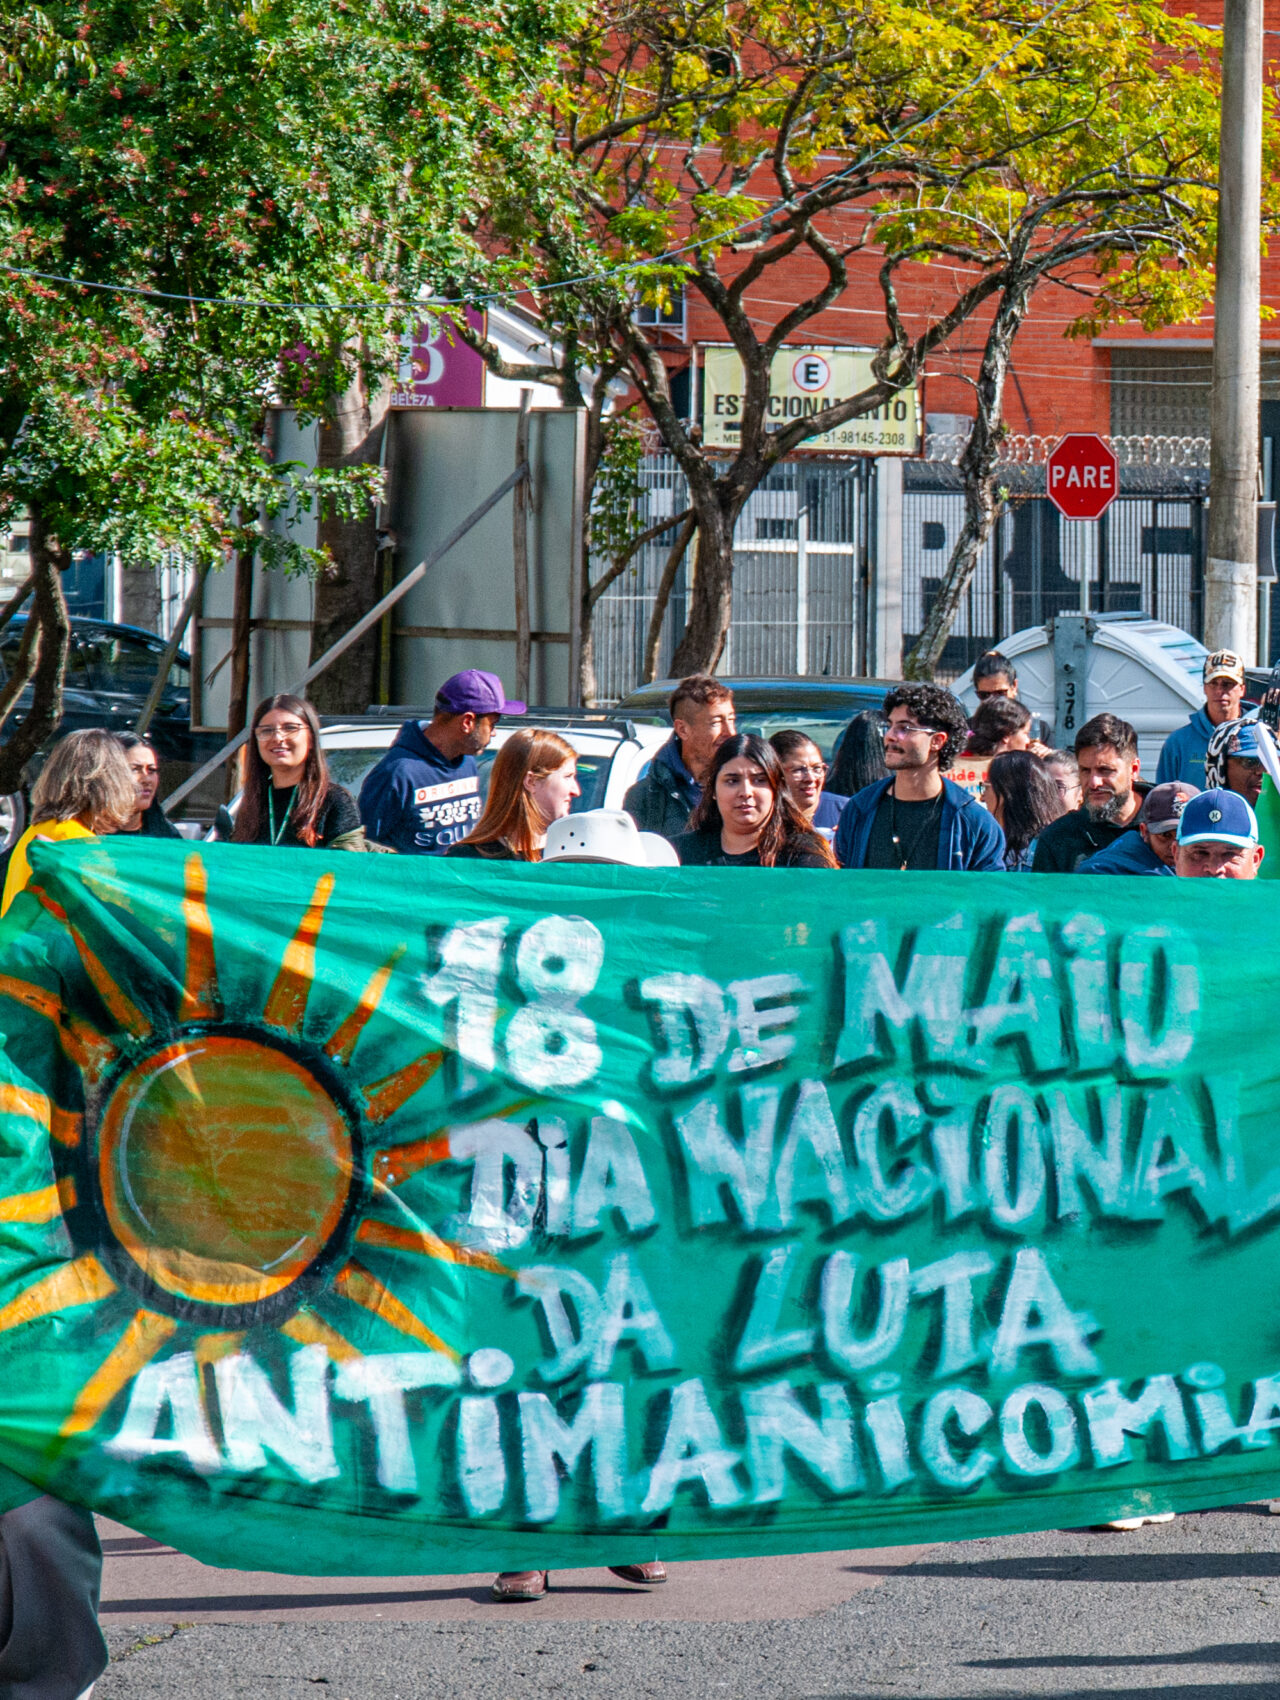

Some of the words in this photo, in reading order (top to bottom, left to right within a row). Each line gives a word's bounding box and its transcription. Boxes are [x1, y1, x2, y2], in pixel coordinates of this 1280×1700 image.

[804, 363, 819, 384] E
[823, 430, 905, 446] 51-98145-2308
[1052, 465, 1112, 488] PARE
[420, 915, 604, 1093] 18
[640, 972, 800, 1083] DE
[517, 1253, 674, 1380] DA
[735, 1243, 1100, 1378] LUTA
